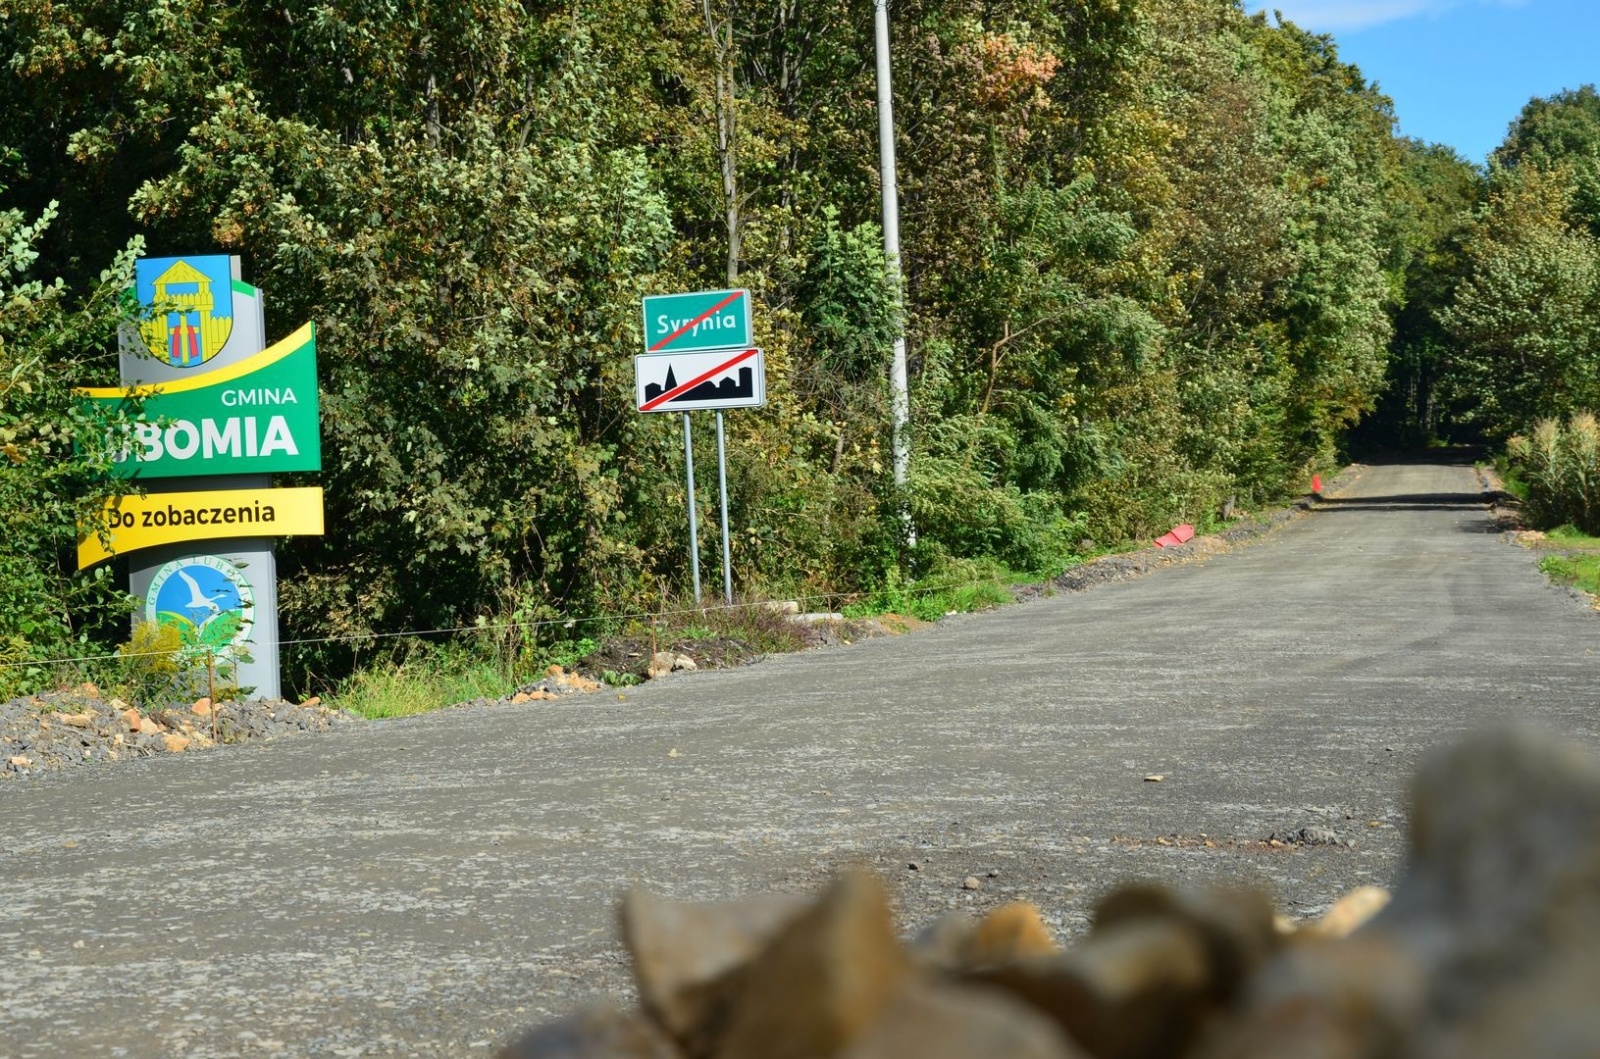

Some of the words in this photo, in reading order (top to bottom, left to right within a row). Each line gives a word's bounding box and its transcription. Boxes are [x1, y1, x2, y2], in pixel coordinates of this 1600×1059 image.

[221, 388, 297, 406] GMINA
[98, 416, 299, 463] UBOMIA
[142, 500, 275, 527] zobaczenia
[148, 560, 184, 606] GMINA
